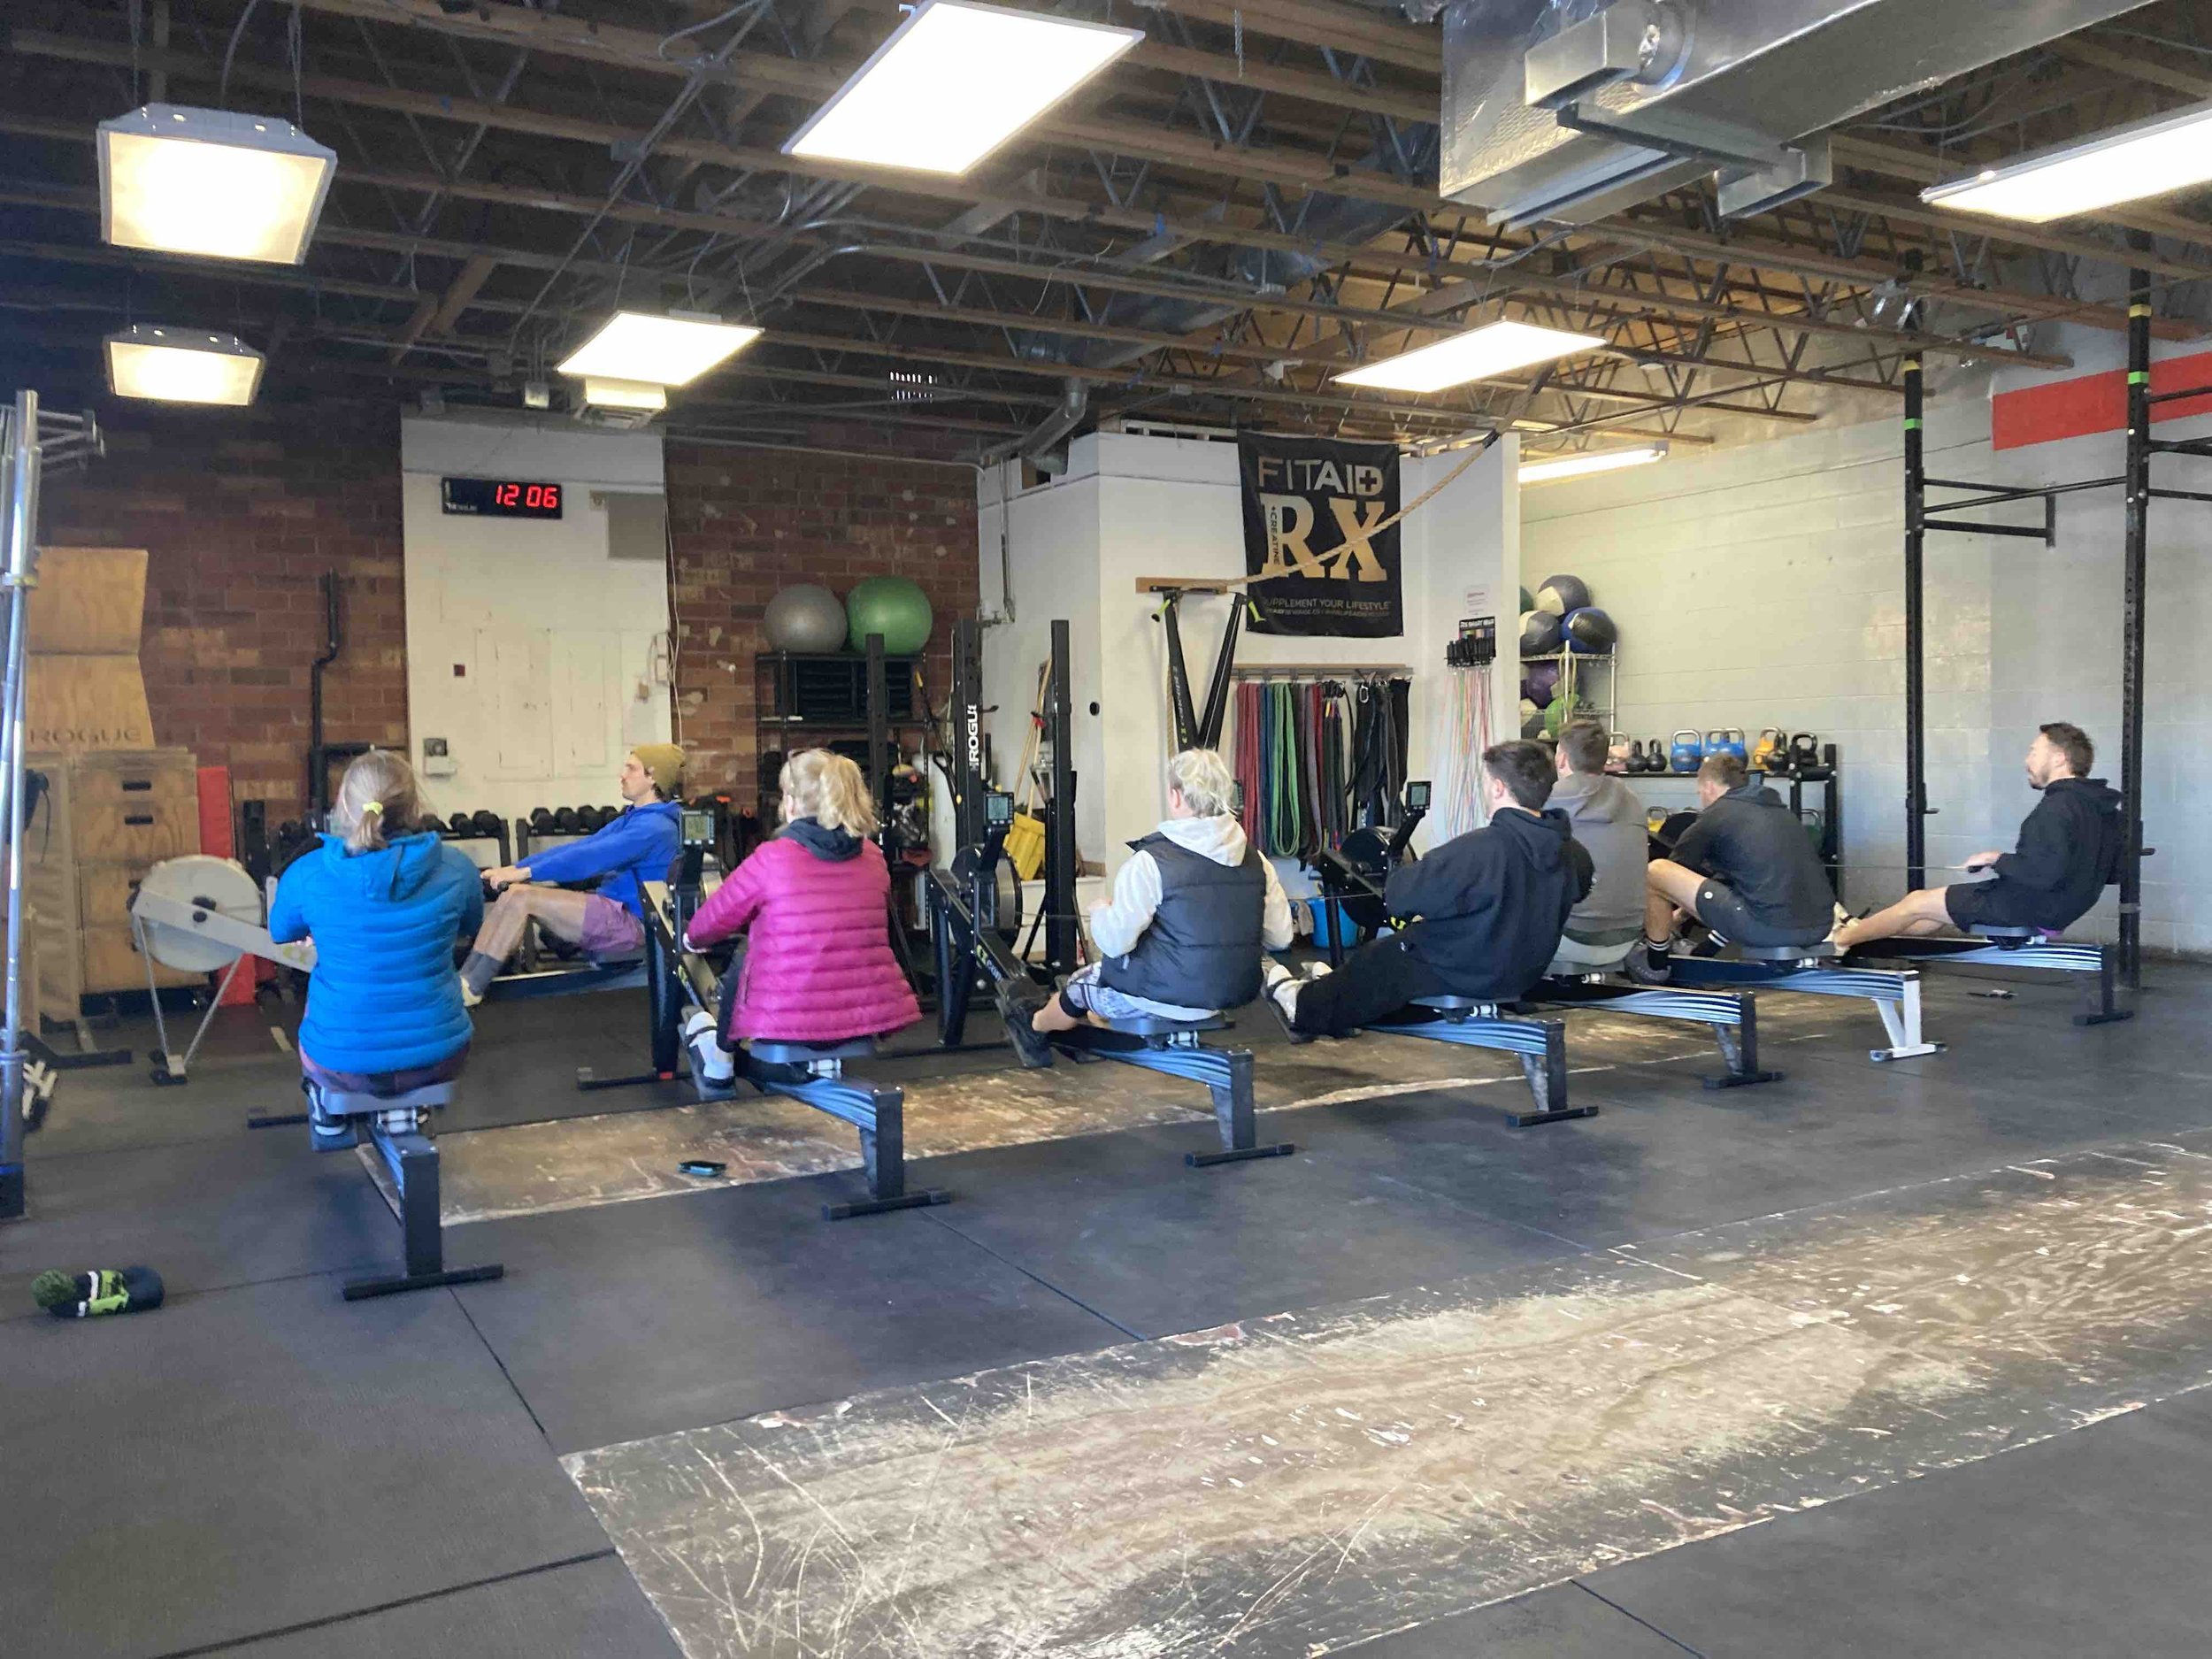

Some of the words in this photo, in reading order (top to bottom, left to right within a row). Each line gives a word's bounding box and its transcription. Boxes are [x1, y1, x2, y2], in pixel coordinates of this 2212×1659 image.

[1258, 456, 1384, 496] FITAID
[1260, 492, 1387, 582] RX
[1318, 598, 1344, 609] YOUR
[30, 728, 142, 744] ROGUE
